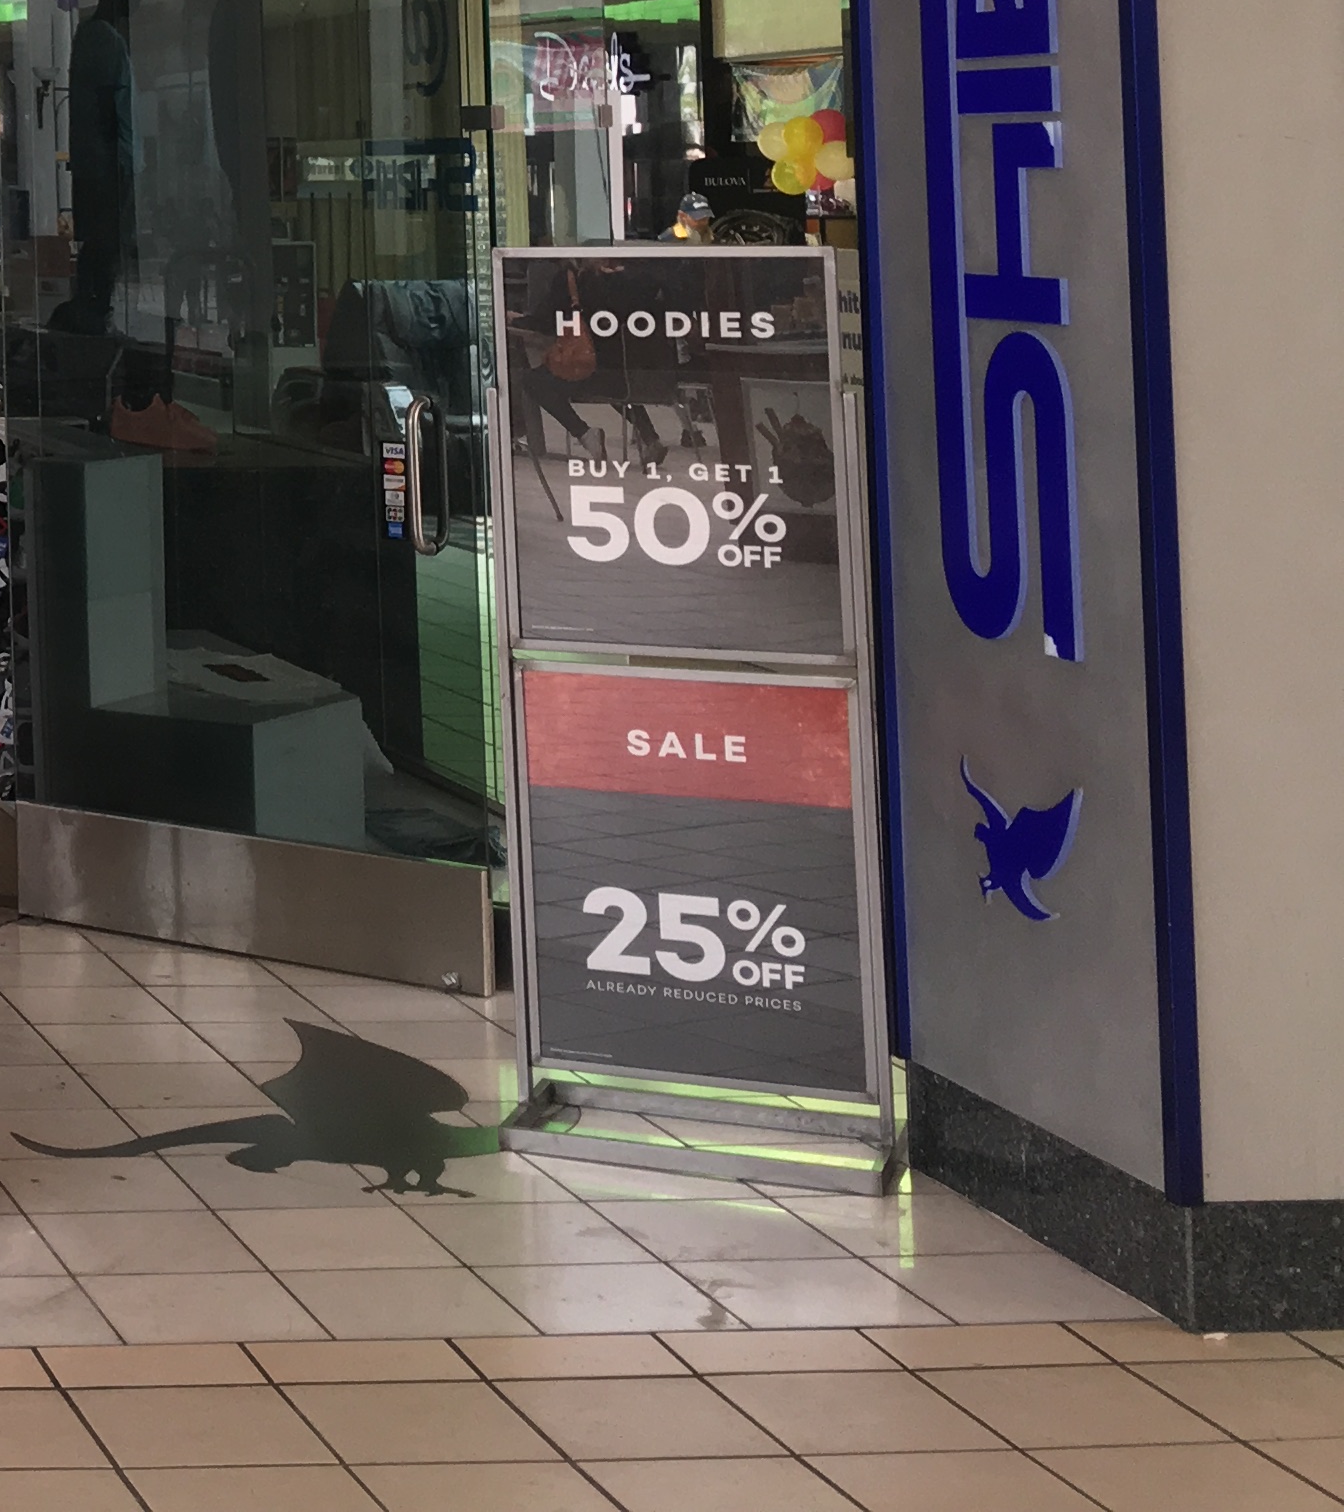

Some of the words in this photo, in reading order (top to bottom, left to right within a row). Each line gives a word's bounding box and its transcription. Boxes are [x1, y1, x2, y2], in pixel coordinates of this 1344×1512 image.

[555, 310, 775, 339] HOODIES
[568, 459, 630, 479] BUY
[689, 463, 752, 483] GET
[768, 466, 784, 484] 1
[567, 485, 787, 566] 50%
[717, 544, 782, 569] OFF
[627, 729, 747, 763] SALE
[582, 886, 806, 982] 25%
[732, 959, 806, 990] OFF
[586, 979, 657, 997] ALREADY
[663, 987, 738, 1005] REDUCED
[745, 995, 803, 1012] PRICES
